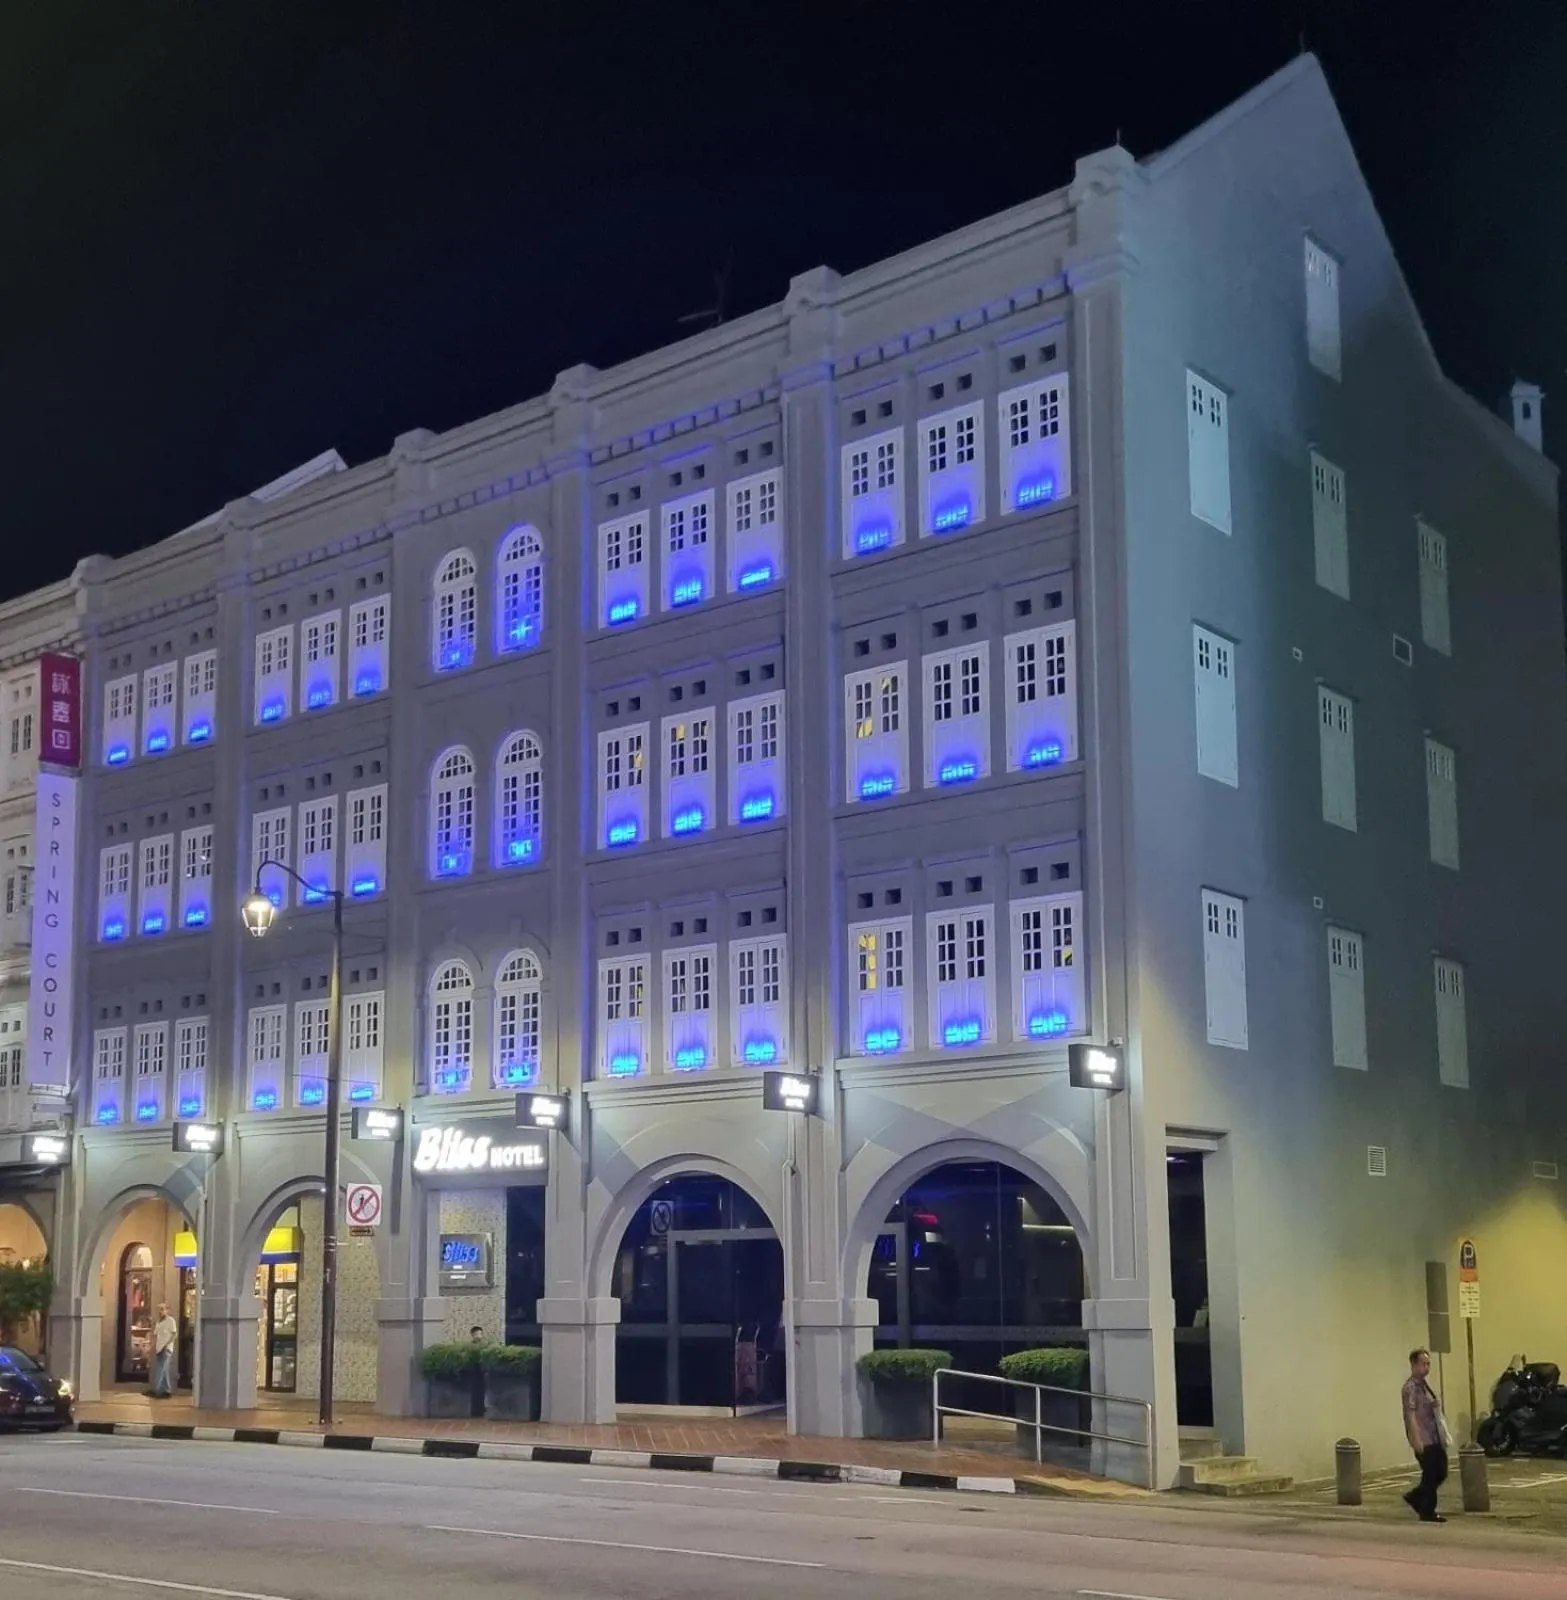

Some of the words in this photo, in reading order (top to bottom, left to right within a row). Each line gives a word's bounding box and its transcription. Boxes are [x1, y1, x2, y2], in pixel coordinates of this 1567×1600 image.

[44, 793, 61, 928] SPRING
[43, 953, 58, 1067] COURT
[413, 1127, 489, 1171] Bliss
[490, 1145, 544, 1167] HOTEL
